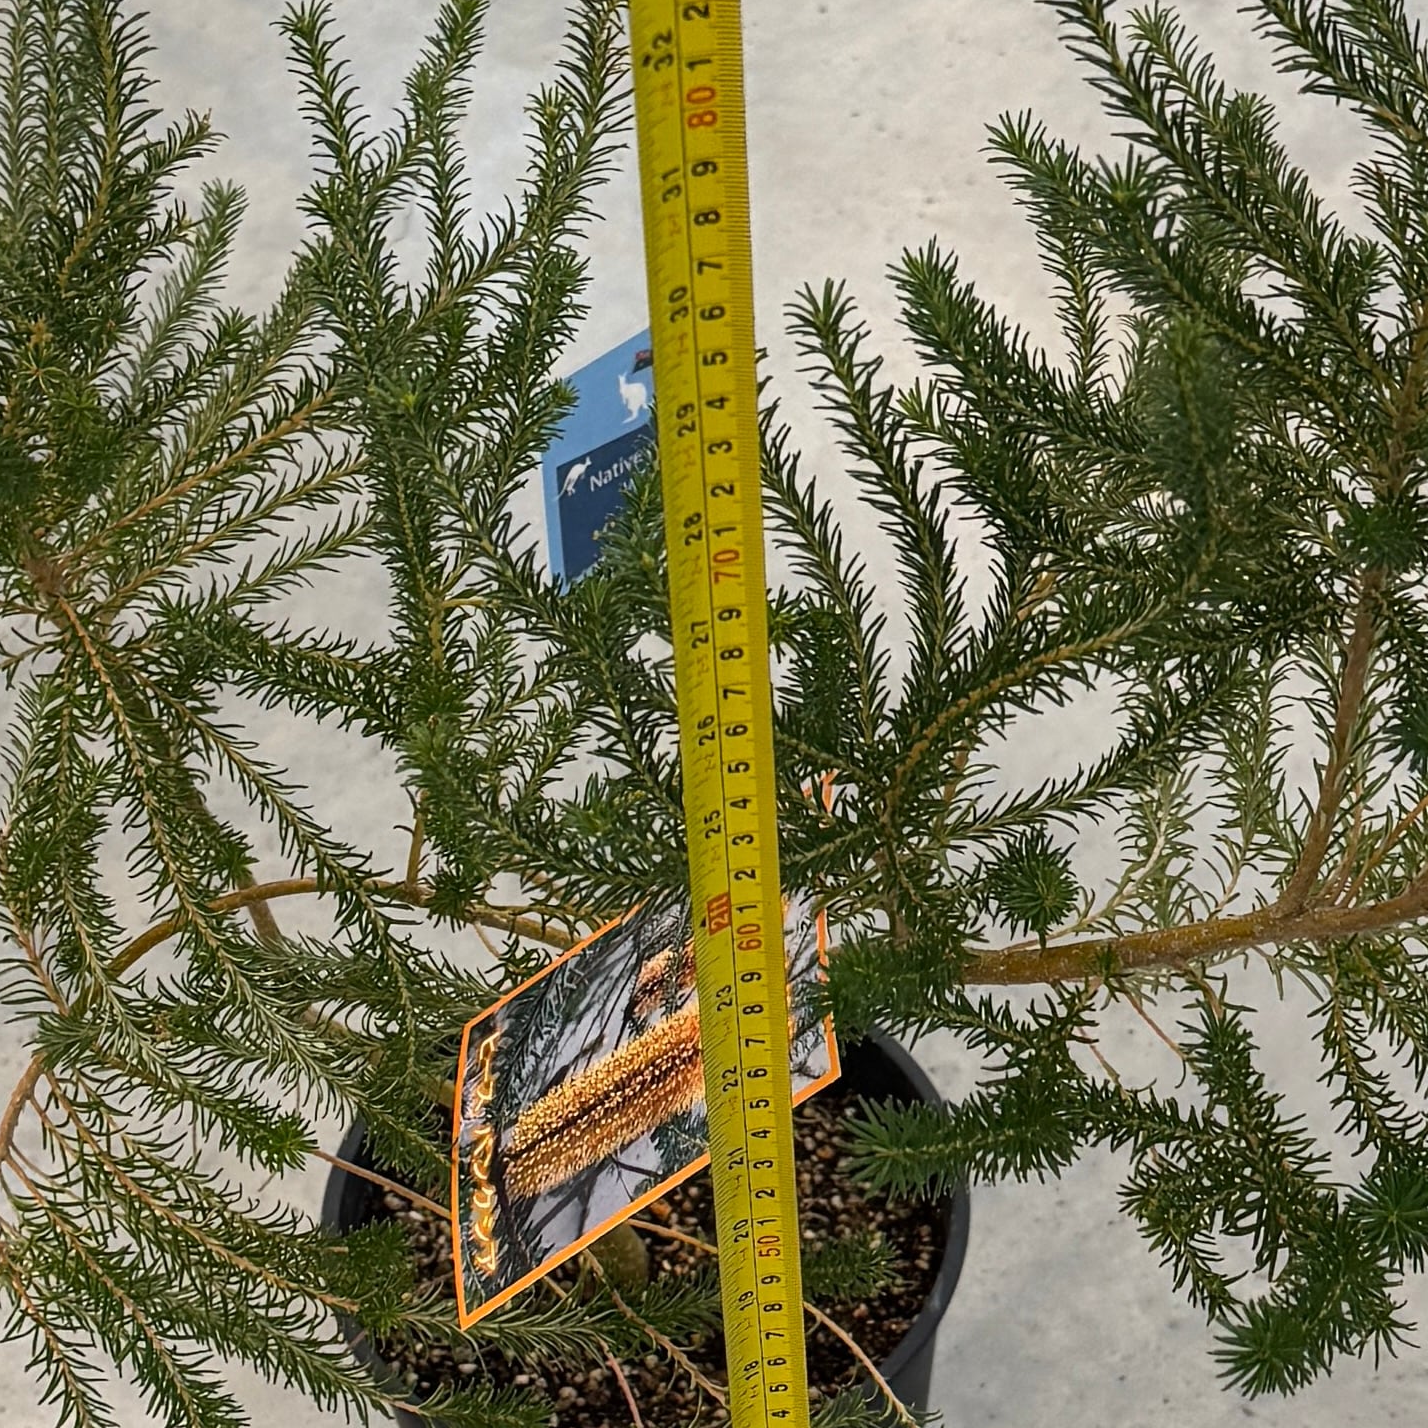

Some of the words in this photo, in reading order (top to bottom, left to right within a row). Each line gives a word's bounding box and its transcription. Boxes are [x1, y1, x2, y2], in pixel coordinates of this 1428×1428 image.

[681, 1, 711, 22] 2
[651, 29, 675, 72] 32
[684, 57, 713, 72] 1
[685, 85, 718, 130] 80
[690, 158, 719, 178] 9
[660, 166, 683, 204] 31
[693, 207, 722, 227] 8
[696, 257, 723, 276] 7
[667, 285, 689, 324] 30
[698, 304, 726, 322] 6
[701, 348, 729, 367] 5
[704, 395, 730, 410] 4
[675, 402, 697, 439] 29
[706, 439, 733, 455] 3
[709, 482, 735, 498] 2
[682, 511, 703, 547] 28
[712, 526, 737, 538] 1
[712, 548, 741, 585] 70
[716, 606, 742, 622] 9
[689, 620, 710, 650] 27
[719, 646, 745, 662] 8
[721, 685, 747, 701] 7
[696, 714, 716, 747] 26
[724, 723, 749, 738] 6
[726, 760, 751, 775] 5
[729, 796, 752, 810] 4
[703, 809, 722, 840] 25
[731, 833, 755, 847] 3
[733, 868, 757, 881] 2
[735, 904, 758, 914] 1
[735, 922, 763, 952] 60
[739, 971, 763, 984] 9
[715, 984, 733, 1013] 23
[741, 1003, 764, 1016] 8
[744, 1037, 766, 1049] 7
[721, 1065, 739, 1093] 22
[746, 1067, 768, 1079] 6
[748, 1098, 770, 1110] 5
[750, 1128, 771, 1139] 4
[726, 1147, 745, 1171] 21
[752, 1159, 774, 1170] 3
[754, 1188, 776, 1200] 2
[732, 1218, 750, 1243] 20
[756, 1218, 777, 1227] 1
[758, 1235, 781, 1258] 50
[760, 1274, 782, 1285] 9
[737, 1290, 754, 1312] 19
[762, 1302, 783, 1313] 8
[764, 1331, 785, 1341] 7
[766, 1356, 787, 1367] 6
[742, 1360, 760, 1381] 18
[768, 1383, 789, 1393] 5
[770, 1409, 790, 1419] 4
